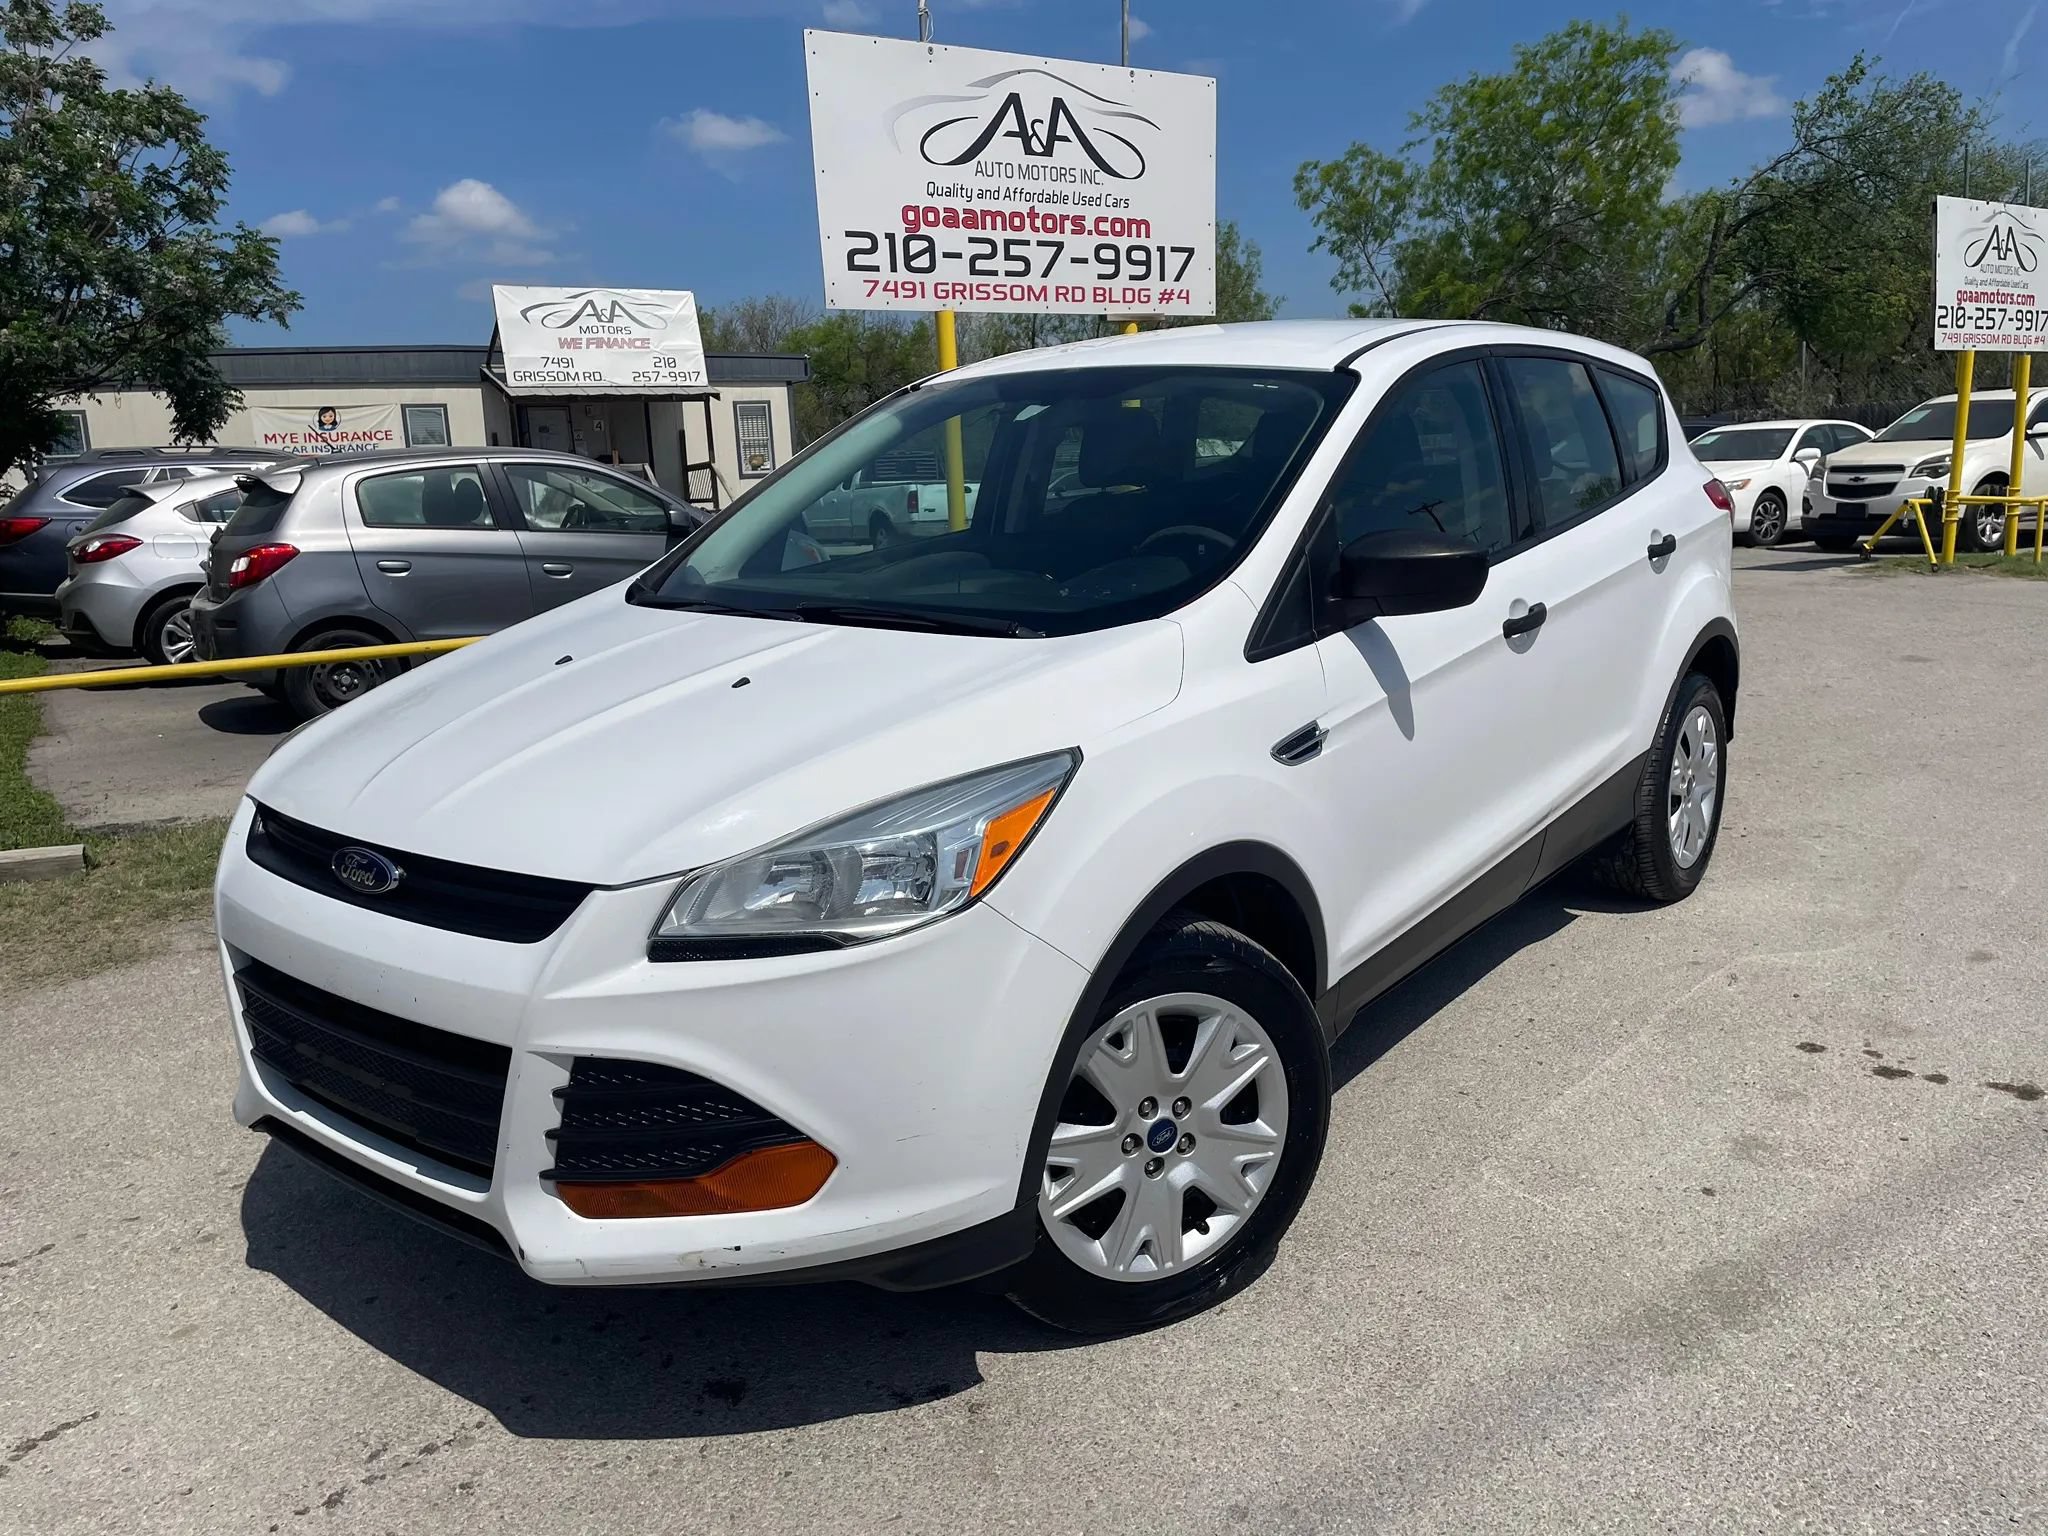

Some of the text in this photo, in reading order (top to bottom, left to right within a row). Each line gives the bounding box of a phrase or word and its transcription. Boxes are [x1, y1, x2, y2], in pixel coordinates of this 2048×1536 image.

[920, 92, 1145, 180] A&A
[975, 160, 1104, 186] AUTO MOTORS INC.
[926, 181, 1130, 209] Quality and Affordable Used Cars
[901, 204, 1151, 239] goaamotors.com
[844, 230, 1196, 283] 210-257-9917
[1964, 224, 2038, 273] A&A
[1980, 264, 1994, 274] AUTO
[862, 279, 1191, 305] 7491 GRISSOM RD BLDG #4
[1957, 288, 2035, 306] goaamotors.com
[541, 299, 668, 330] A&A
[1937, 305, 2048, 332] 210-257-9917
[579, 325, 632, 335] MOTORS
[1941, 332, 2046, 345] 7491 GRISSOM RD BLDG #4
[558, 337, 651, 349] WE FINANCE
[541, 356, 575, 369] 7491
[652, 356, 677, 369] 210
[513, 370, 606, 382] GRISSOM RD.
[631, 371, 701, 382] 257-9917
[264, 430, 394, 445] MYE INSURANCE
[281, 445, 309, 455] CAR
[341, 853, 378, 887] Ford
